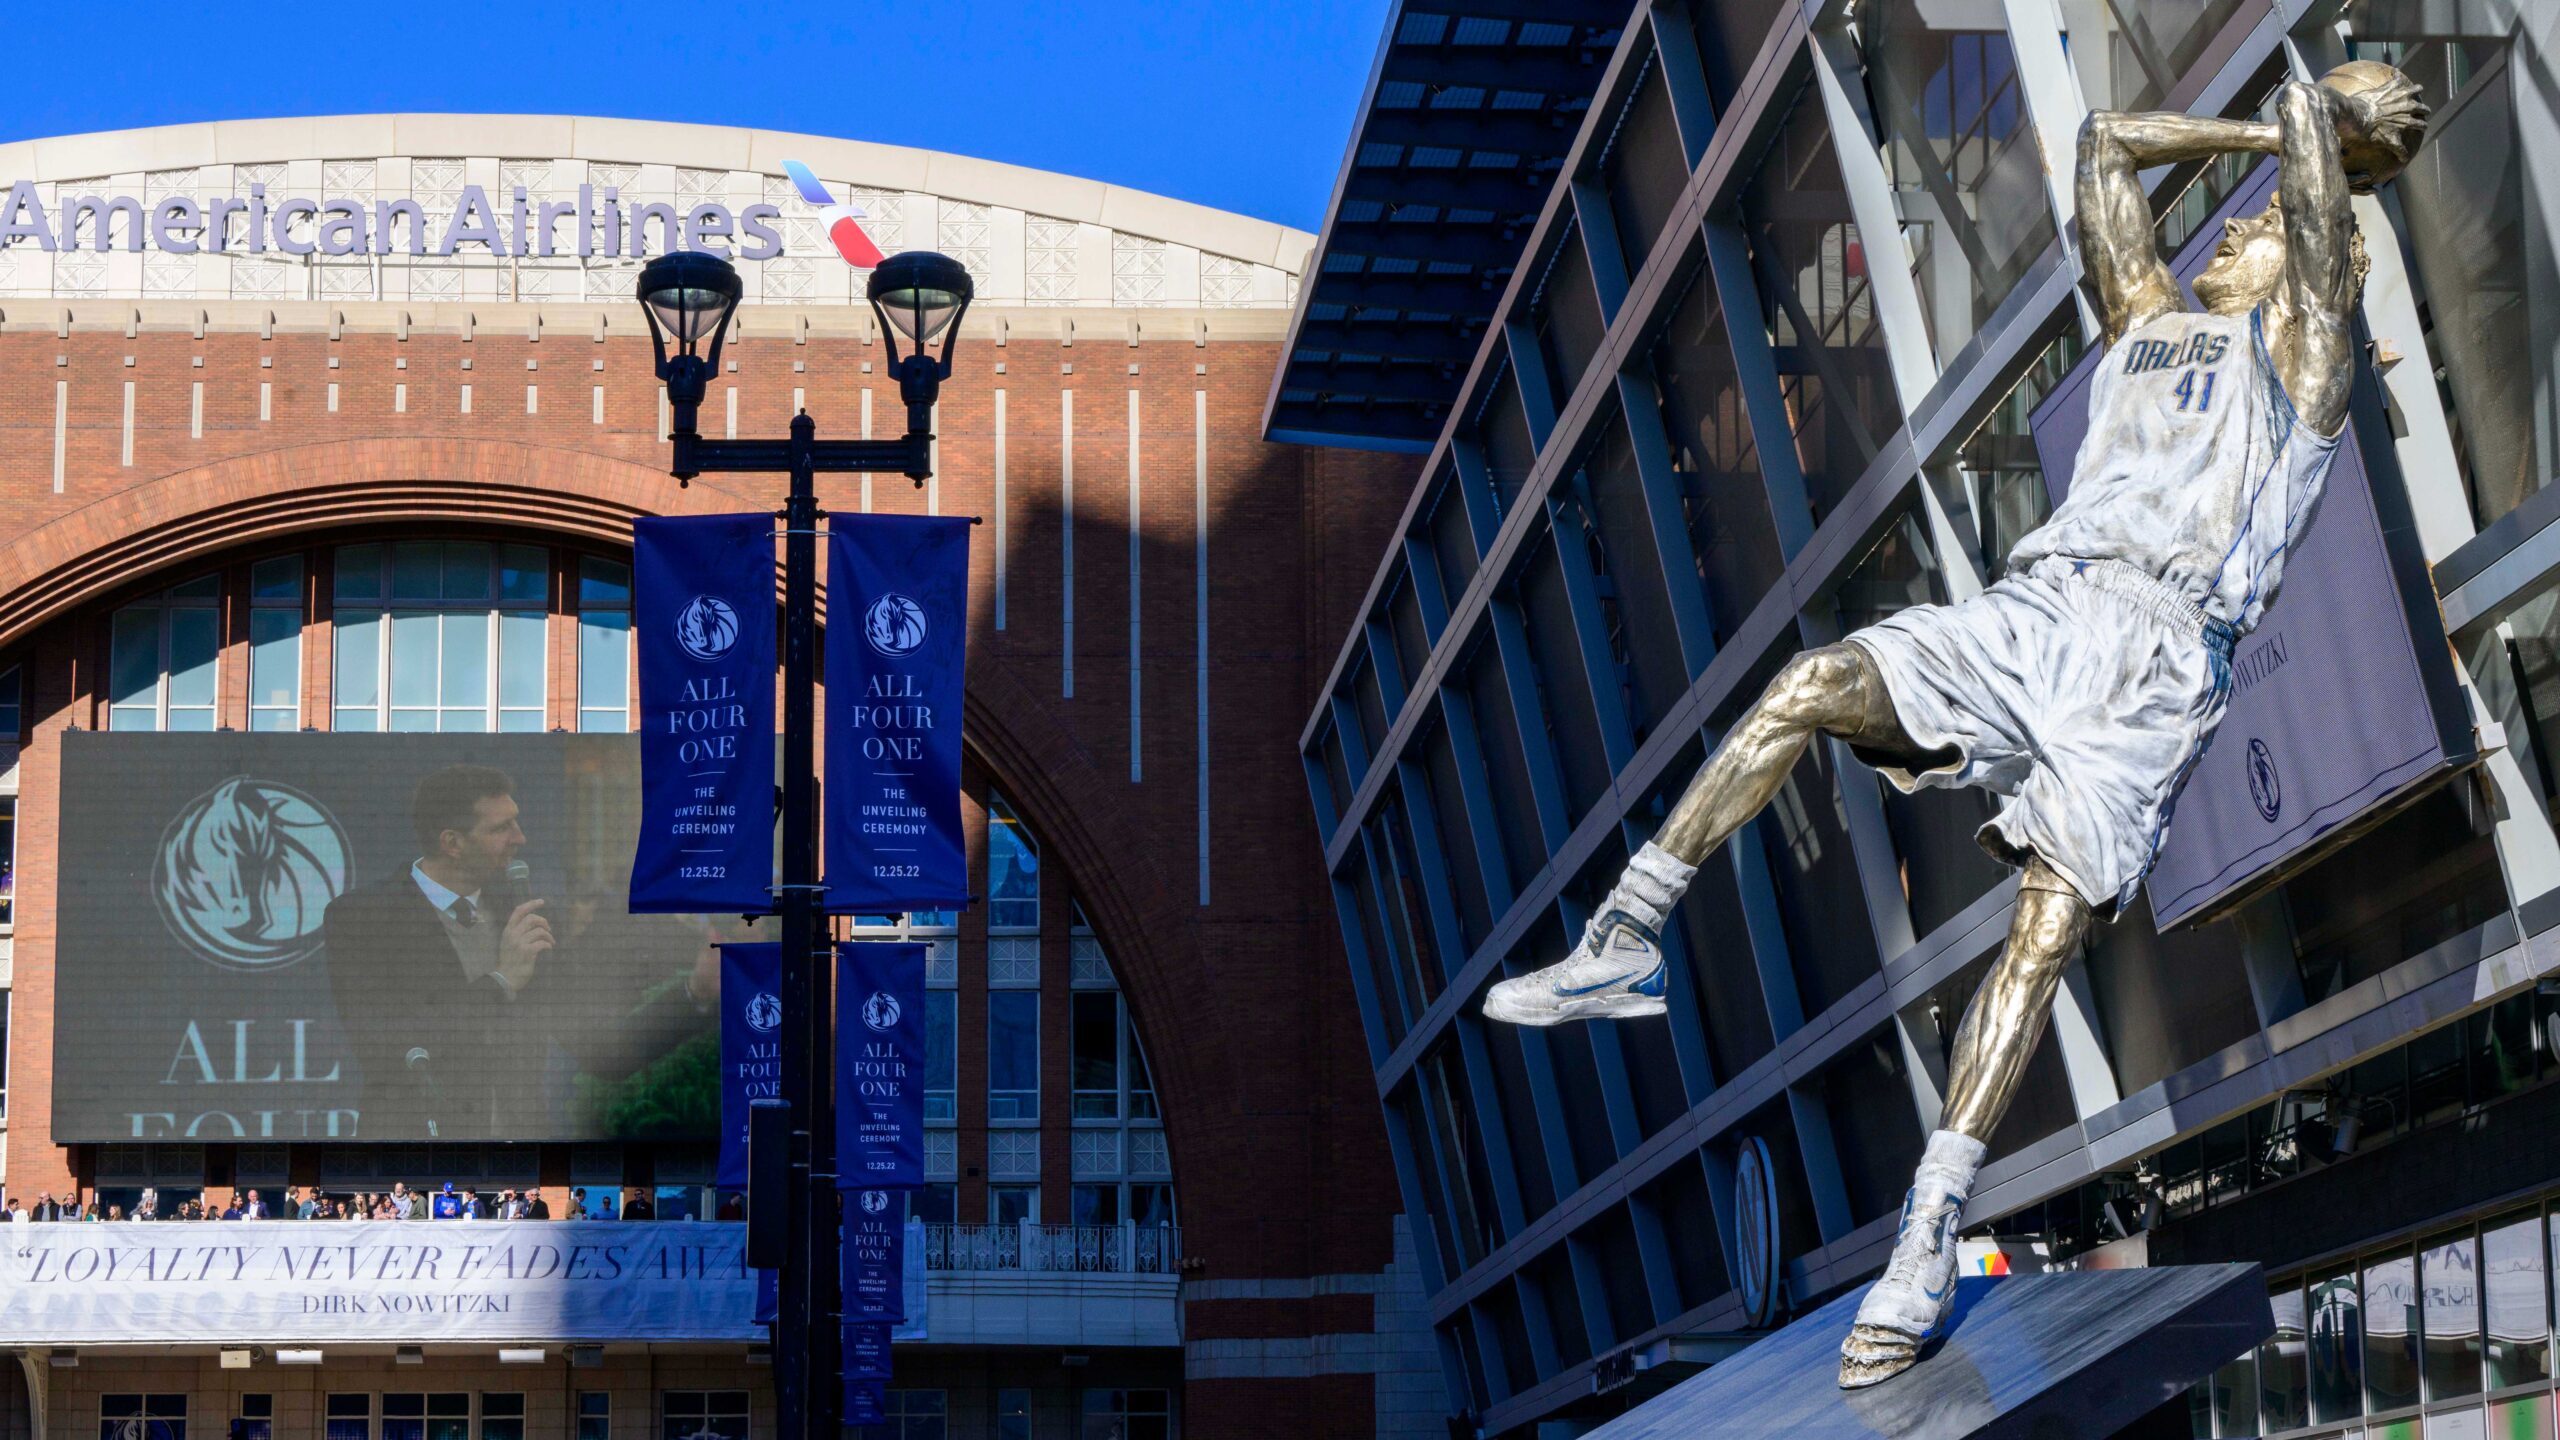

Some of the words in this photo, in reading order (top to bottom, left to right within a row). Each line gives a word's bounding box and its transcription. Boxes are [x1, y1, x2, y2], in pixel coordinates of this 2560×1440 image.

[0, 180, 424, 257] American
[439, 184, 784, 261] Airlines
[2124, 332, 2230, 374] DALLAS
[2174, 369, 2216, 412] 41
[2231, 632, 2289, 697] OWITZKI
[680, 676, 736, 702] ALL
[864, 674, 922, 698] ALL
[668, 705, 748, 734] FOUR
[852, 705, 934, 729] FOUR
[679, 736, 736, 764] ONE
[862, 737, 922, 760] ONE
[694, 787, 715, 799] THE
[883, 787, 905, 799] THE
[674, 805, 736, 818] UNVEILING
[862, 805, 927, 818] UNVEILING
[672, 823, 735, 835] CEREMONY
[862, 823, 927, 835] CEREMONY
[680, 866, 726, 879] 12.25.22
[873, 865, 920, 878] 12.25.22
[159, 1018, 340, 1085] ALL
[860, 1043, 900, 1058] ALL
[739, 1062, 781, 1078] FOU
[854, 1062, 906, 1078] FOUR
[860, 1081, 900, 1097] ONE
[872, 1112, 888, 1121] THE
[860, 1123, 901, 1132] UNVEILING
[860, 1134, 901, 1143] CEREMONY
[866, 1161, 896, 1171] 12.25.22
[862, 1221, 887, 1233] ALL
[855, 1235, 891, 1247] FOUR
[859, 1248, 887, 1261] ONE
[264, 1245, 443, 1282] NEVER
[455, 1245, 629, 1281] FADES
[635, 1245, 750, 1281] AWA
[302, 1294, 368, 1314] DIRK
[376, 1294, 511, 1314] NOWITZKI
